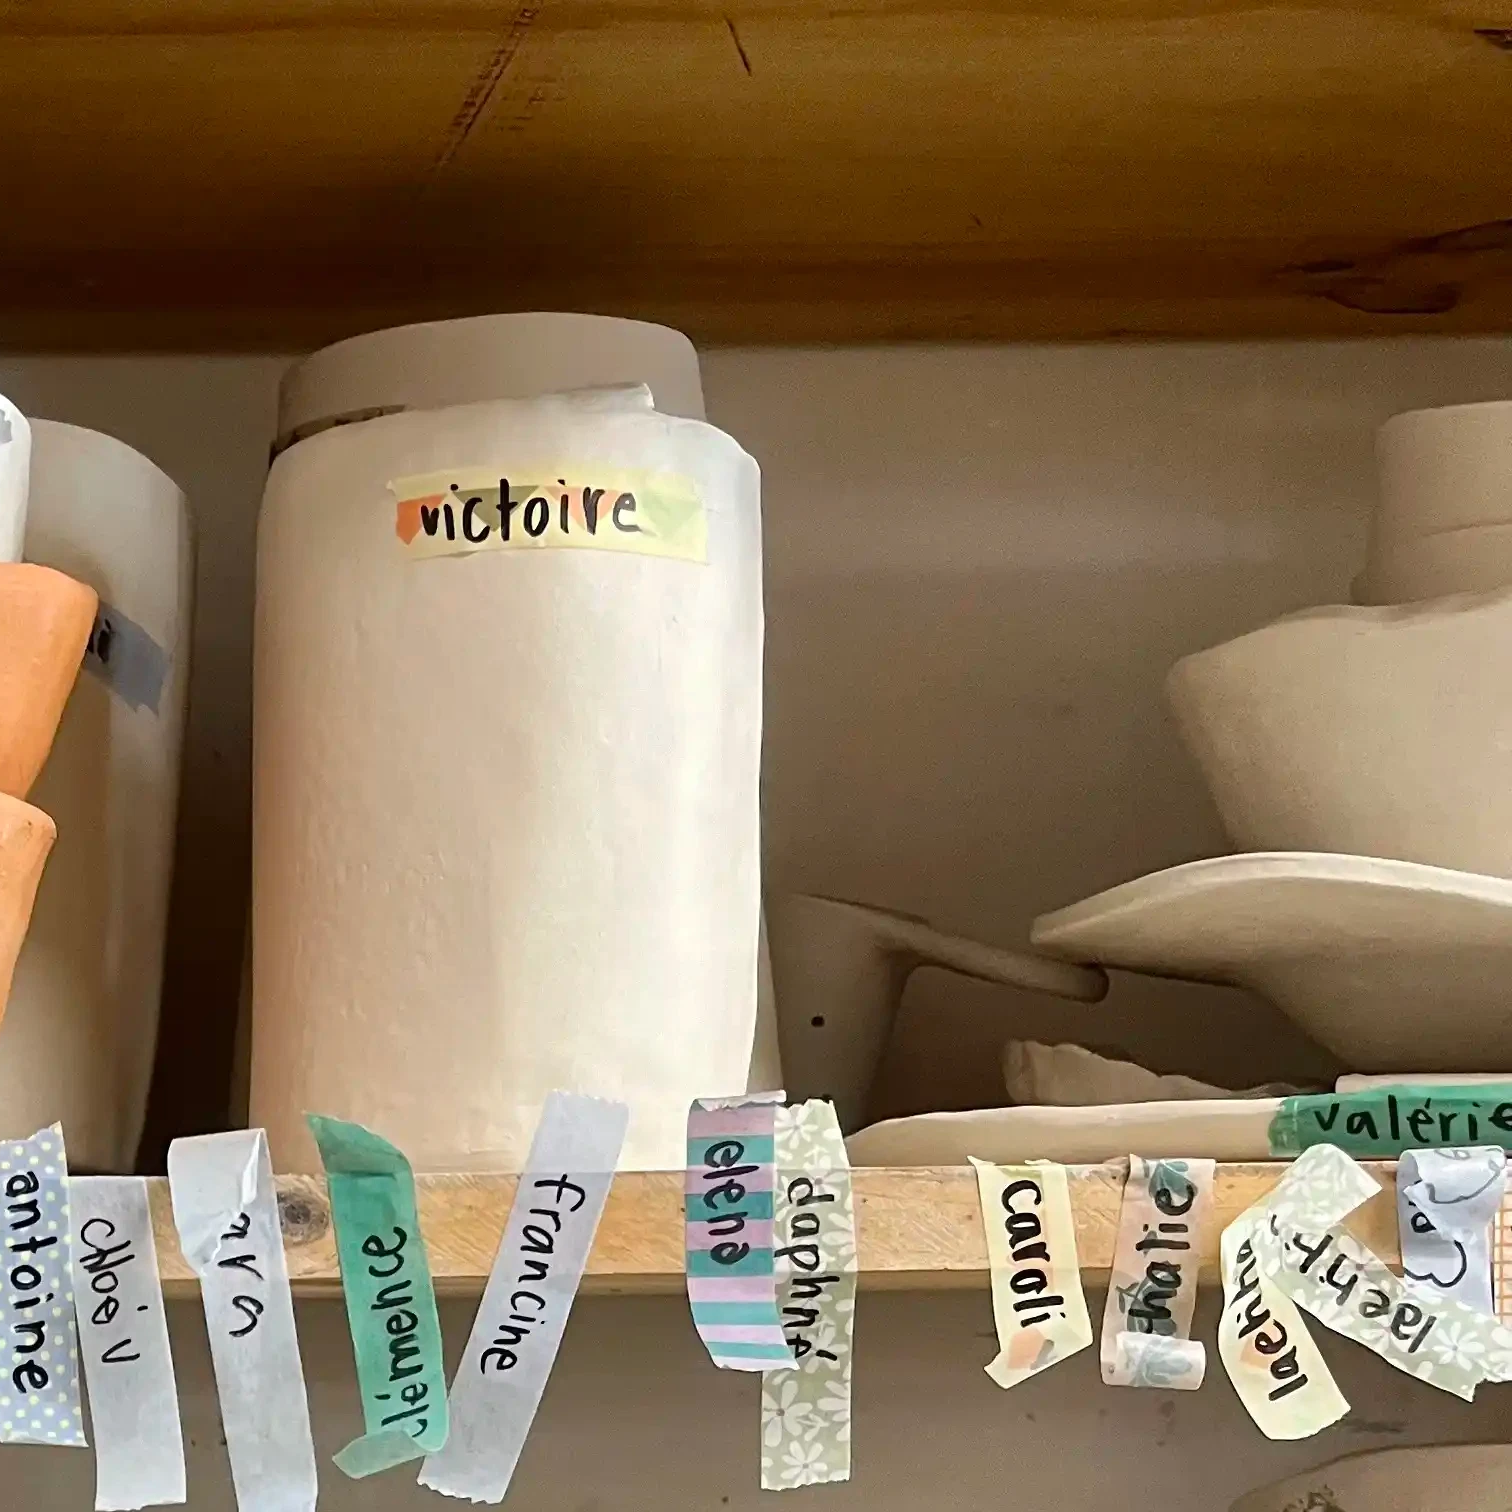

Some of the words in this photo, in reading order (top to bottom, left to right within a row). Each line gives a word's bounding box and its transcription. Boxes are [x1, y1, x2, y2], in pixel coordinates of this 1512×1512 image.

[420, 477, 642, 544] victoire
[4, 1171, 59, 1393] antoine
[480, 1173, 587, 1375] francine
[702, 1139, 759, 1265] elena
